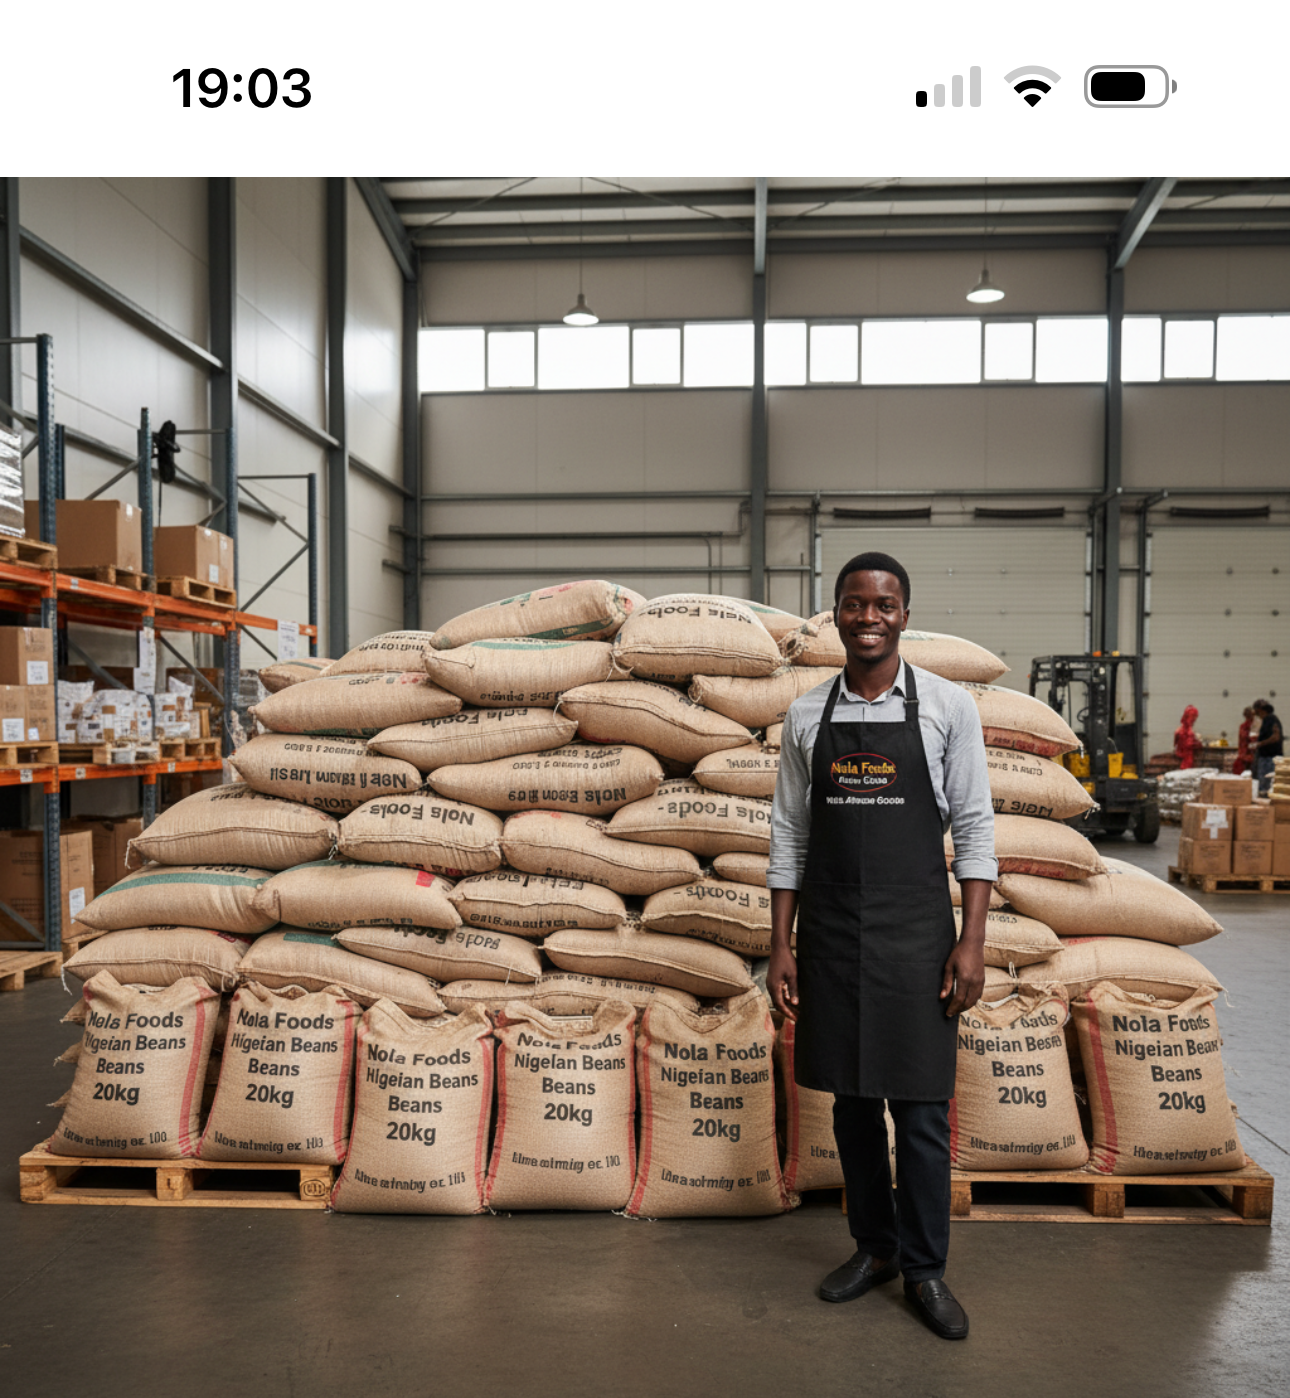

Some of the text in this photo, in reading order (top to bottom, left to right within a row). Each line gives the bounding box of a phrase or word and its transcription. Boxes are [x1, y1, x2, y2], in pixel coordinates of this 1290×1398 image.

[171, 68, 311, 108] 19:03
[125, 1011, 184, 1030] Foods
[275, 1012, 335, 1030] Foods
[1112, 1014, 1162, 1033] Nola
[135, 1034, 186, 1051] Beans
[290, 1036, 339, 1053] Beans
[664, 1042, 767, 1061] Nola Foods
[957, 1034, 1023, 1056] Nigeian
[1114, 1039, 1184, 1061] Nigeian
[367, 1043, 472, 1066] Nola Foods
[582, 1054, 626, 1071] Beans
[95, 1057, 145, 1075] Beans
[247, 1058, 300, 1077] Beans
[991, 1060, 1044, 1078] Beans
[1151, 1064, 1203, 1083] Beans
[429, 1073, 479, 1089] Beans
[541, 1076, 596, 1096] Beans
[92, 1082, 140, 1106] 20kg
[245, 1083, 294, 1109] 20kg
[689, 1091, 744, 1110] Beans
[997, 1086, 1047, 1109] 20kg
[1158, 1091, 1207, 1114] 20kg
[387, 1095, 443, 1114] Beans
[543, 1102, 593, 1127] 20kg
[386, 1121, 437, 1147] 20kg
[692, 1118, 741, 1143] 20kg
